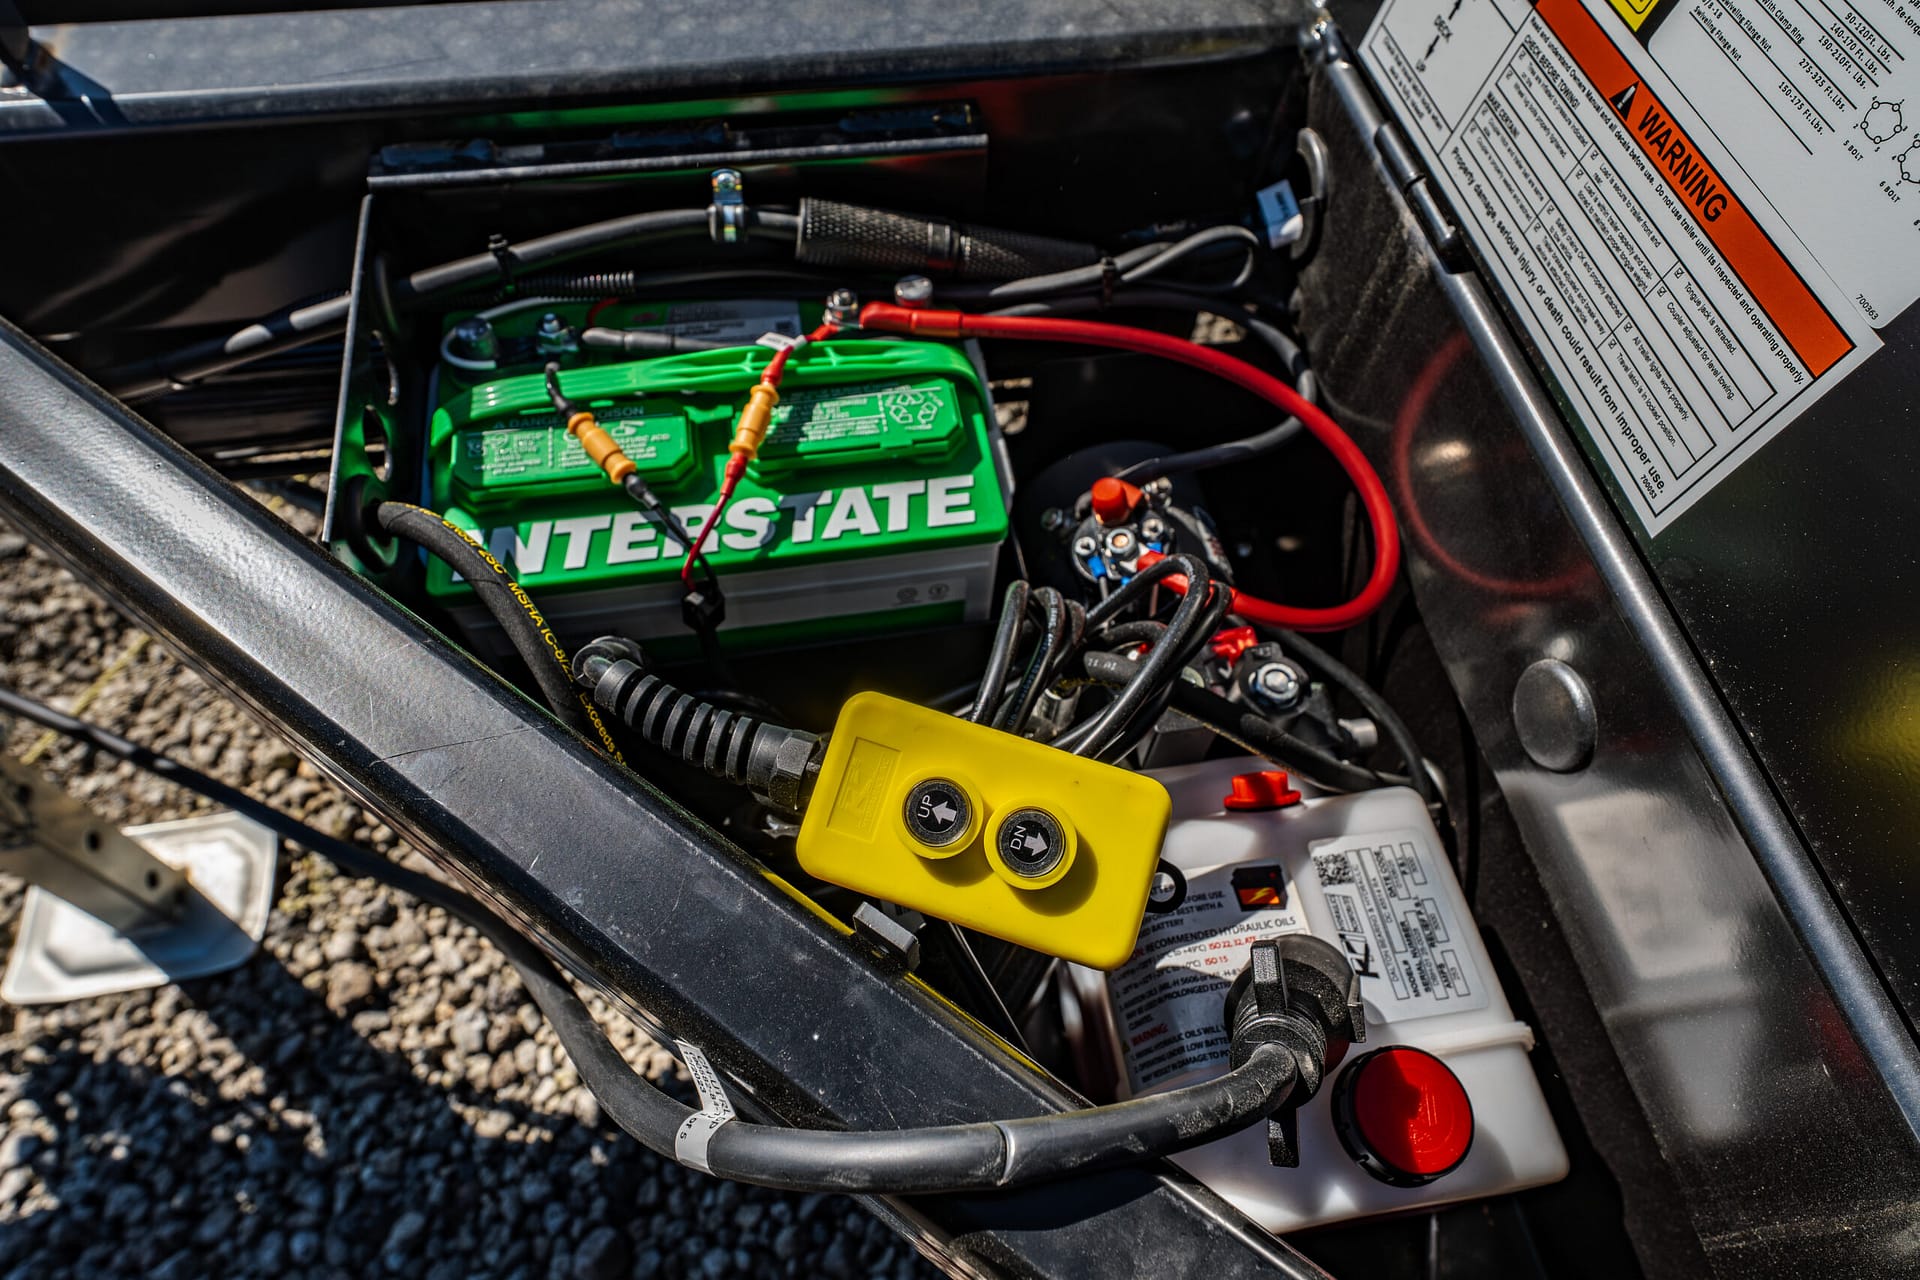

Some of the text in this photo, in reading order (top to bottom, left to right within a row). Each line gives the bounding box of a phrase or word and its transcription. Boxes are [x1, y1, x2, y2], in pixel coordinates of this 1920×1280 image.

[1434, 14, 1452, 42] DECK
[1693, 5, 1741, 61] Swiveling Flange Nut
[1743, 19, 1761, 41] Flange
[1759, 37, 1771, 52] Nut
[1773, 9, 1792, 30] Clamp
[1790, 26, 1805, 44] Ring
[1844, 12, 1891, 63] 90-120Ft. Lbs.
[1524, 34, 1541, 58] CHECK
[1538, 54, 1560, 83] BEFORE
[1818, 35, 1866, 89] 190-210Ft. Lbs.
[1830, 22, 1877, 76] 140-170 Ft. Lbs.
[1798, 58, 1845, 112] 275-325 Ft.Lbs.
[1778, 81, 1823, 135] 150-175 Ft.Lbs.
[1638, 105, 1728, 223] WARNING
[1847, 144, 1863, 161] BOLT
[1883, 185, 1901, 203] BOLT
[1569, 68, 1586, 93] Owners
[1585, 89, 1603, 113] Manual
[1599, 111, 1611, 125] and
[1608, 122, 1617, 132] all
[1614, 130, 1631, 152] decals
[1628, 148, 1645, 172] before
[1643, 169, 1654, 185] use.
[1654, 183, 1664, 196] Do
[1662, 195, 1674, 209] not
[1671, 206, 1682, 221] use
[1680, 217, 1697, 240] trailer
[1695, 238, 1711, 256] until
[1739, 298, 1754, 315] and
[1750, 313, 1779, 352] operating
[1774, 349, 1804, 385] properly.
[1684, 281, 1737, 355] Tongue jack is retracted.
[1855, 293, 1879, 320] 700363
[1473, 183, 1497, 223] damage,
[1496, 220, 1519, 256] serious
[1517, 252, 1537, 286] injury,
[1536, 284, 1546, 296] or
[1543, 296, 1563, 326] death
[1561, 325, 1584, 356] could
[1579, 354, 1603, 387] result
[1598, 384, 1618, 414] from
[1615, 411, 1651, 465] improper
[1648, 465, 1664, 493] use.
[1666, 301, 1735, 400] Coupler adjusted for level towing.
[1632, 336, 1689, 421] All trailer lights work properly.
[1616, 352, 1676, 447] Travel latch is in locked position.
[453, 474, 976, 583] NTERSTATE
[508, 580, 544, 628] MSHA
[579, 692, 616, 752] Exceeds
[917, 793, 933, 819] UP
[1009, 825, 1027, 851] DN
[1374, 851, 1387, 873] CODE
[1383, 876, 1396, 898] DATE
[1152, 919, 1184, 933] BATTERY
[1176, 905, 1194, 916] BEST
[1196, 903, 1216, 912] WITH
[1145, 916, 1296, 953] RECOMMENDED HYDRAULIC OILS
[1208, 942, 1222, 950] ISO
[1400, 921, 1418, 958] NUMBER
[1204, 958, 1218, 966] ISO
[1415, 960, 1431, 992] SERIAL
[1435, 963, 1452, 988] AMPS
[1184, 1025, 1220, 1039] OILS WILL
[1186, 1042, 1204, 1053] LOW
